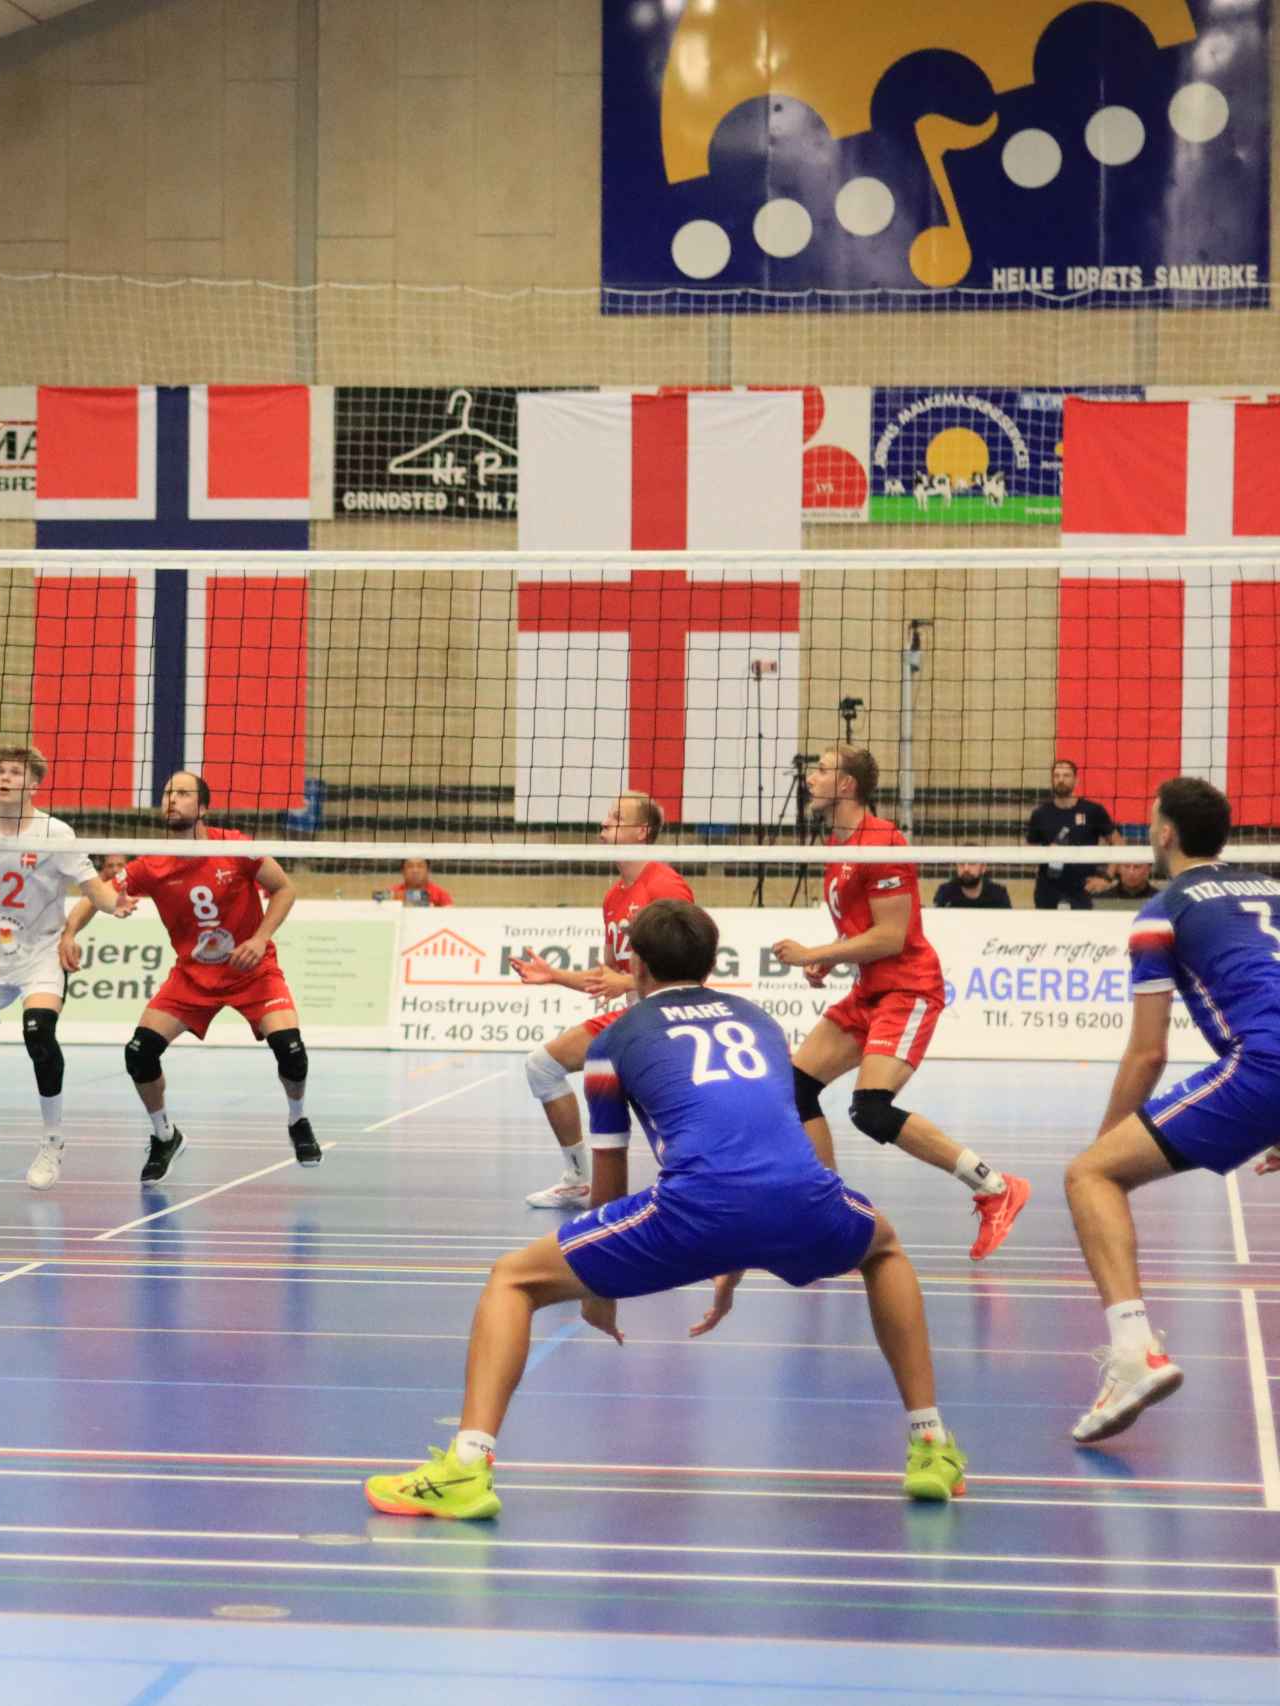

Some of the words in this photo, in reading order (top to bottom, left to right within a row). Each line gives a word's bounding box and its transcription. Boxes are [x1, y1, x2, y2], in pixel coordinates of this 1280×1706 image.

[992, 267, 1054, 291] HELLE
[1067, 266, 1143, 290] IDRÆTS
[1154, 265, 1258, 290] SAMVIRKE
[343, 491, 448, 511] GRINDSTED
[189, 885, 218, 920] 8
[504, 925, 604, 937] Tømrerfirm
[78, 937, 163, 970] jerg
[981, 937, 1047, 962] Energi
[1053, 939, 1117, 964] rigtige
[67, 974, 156, 1000] cent
[401, 996, 530, 1017] Hostrupvej
[541, 998, 561, 1013] 11
[660, 1002, 734, 1021] MARE
[761, 1000, 803, 1017] 800
[983, 1010, 1013, 1028] Tlf.
[1022, 1011, 1069, 1028] 7519
[1075, 1012, 1123, 1029] 6200
[401, 1023, 435, 1041] Tlf.
[445, 1024, 473, 1041] 40
[481, 1025, 508, 1041] 35
[516, 1025, 544, 1042] 06
[665, 1021, 768, 1086] 28
